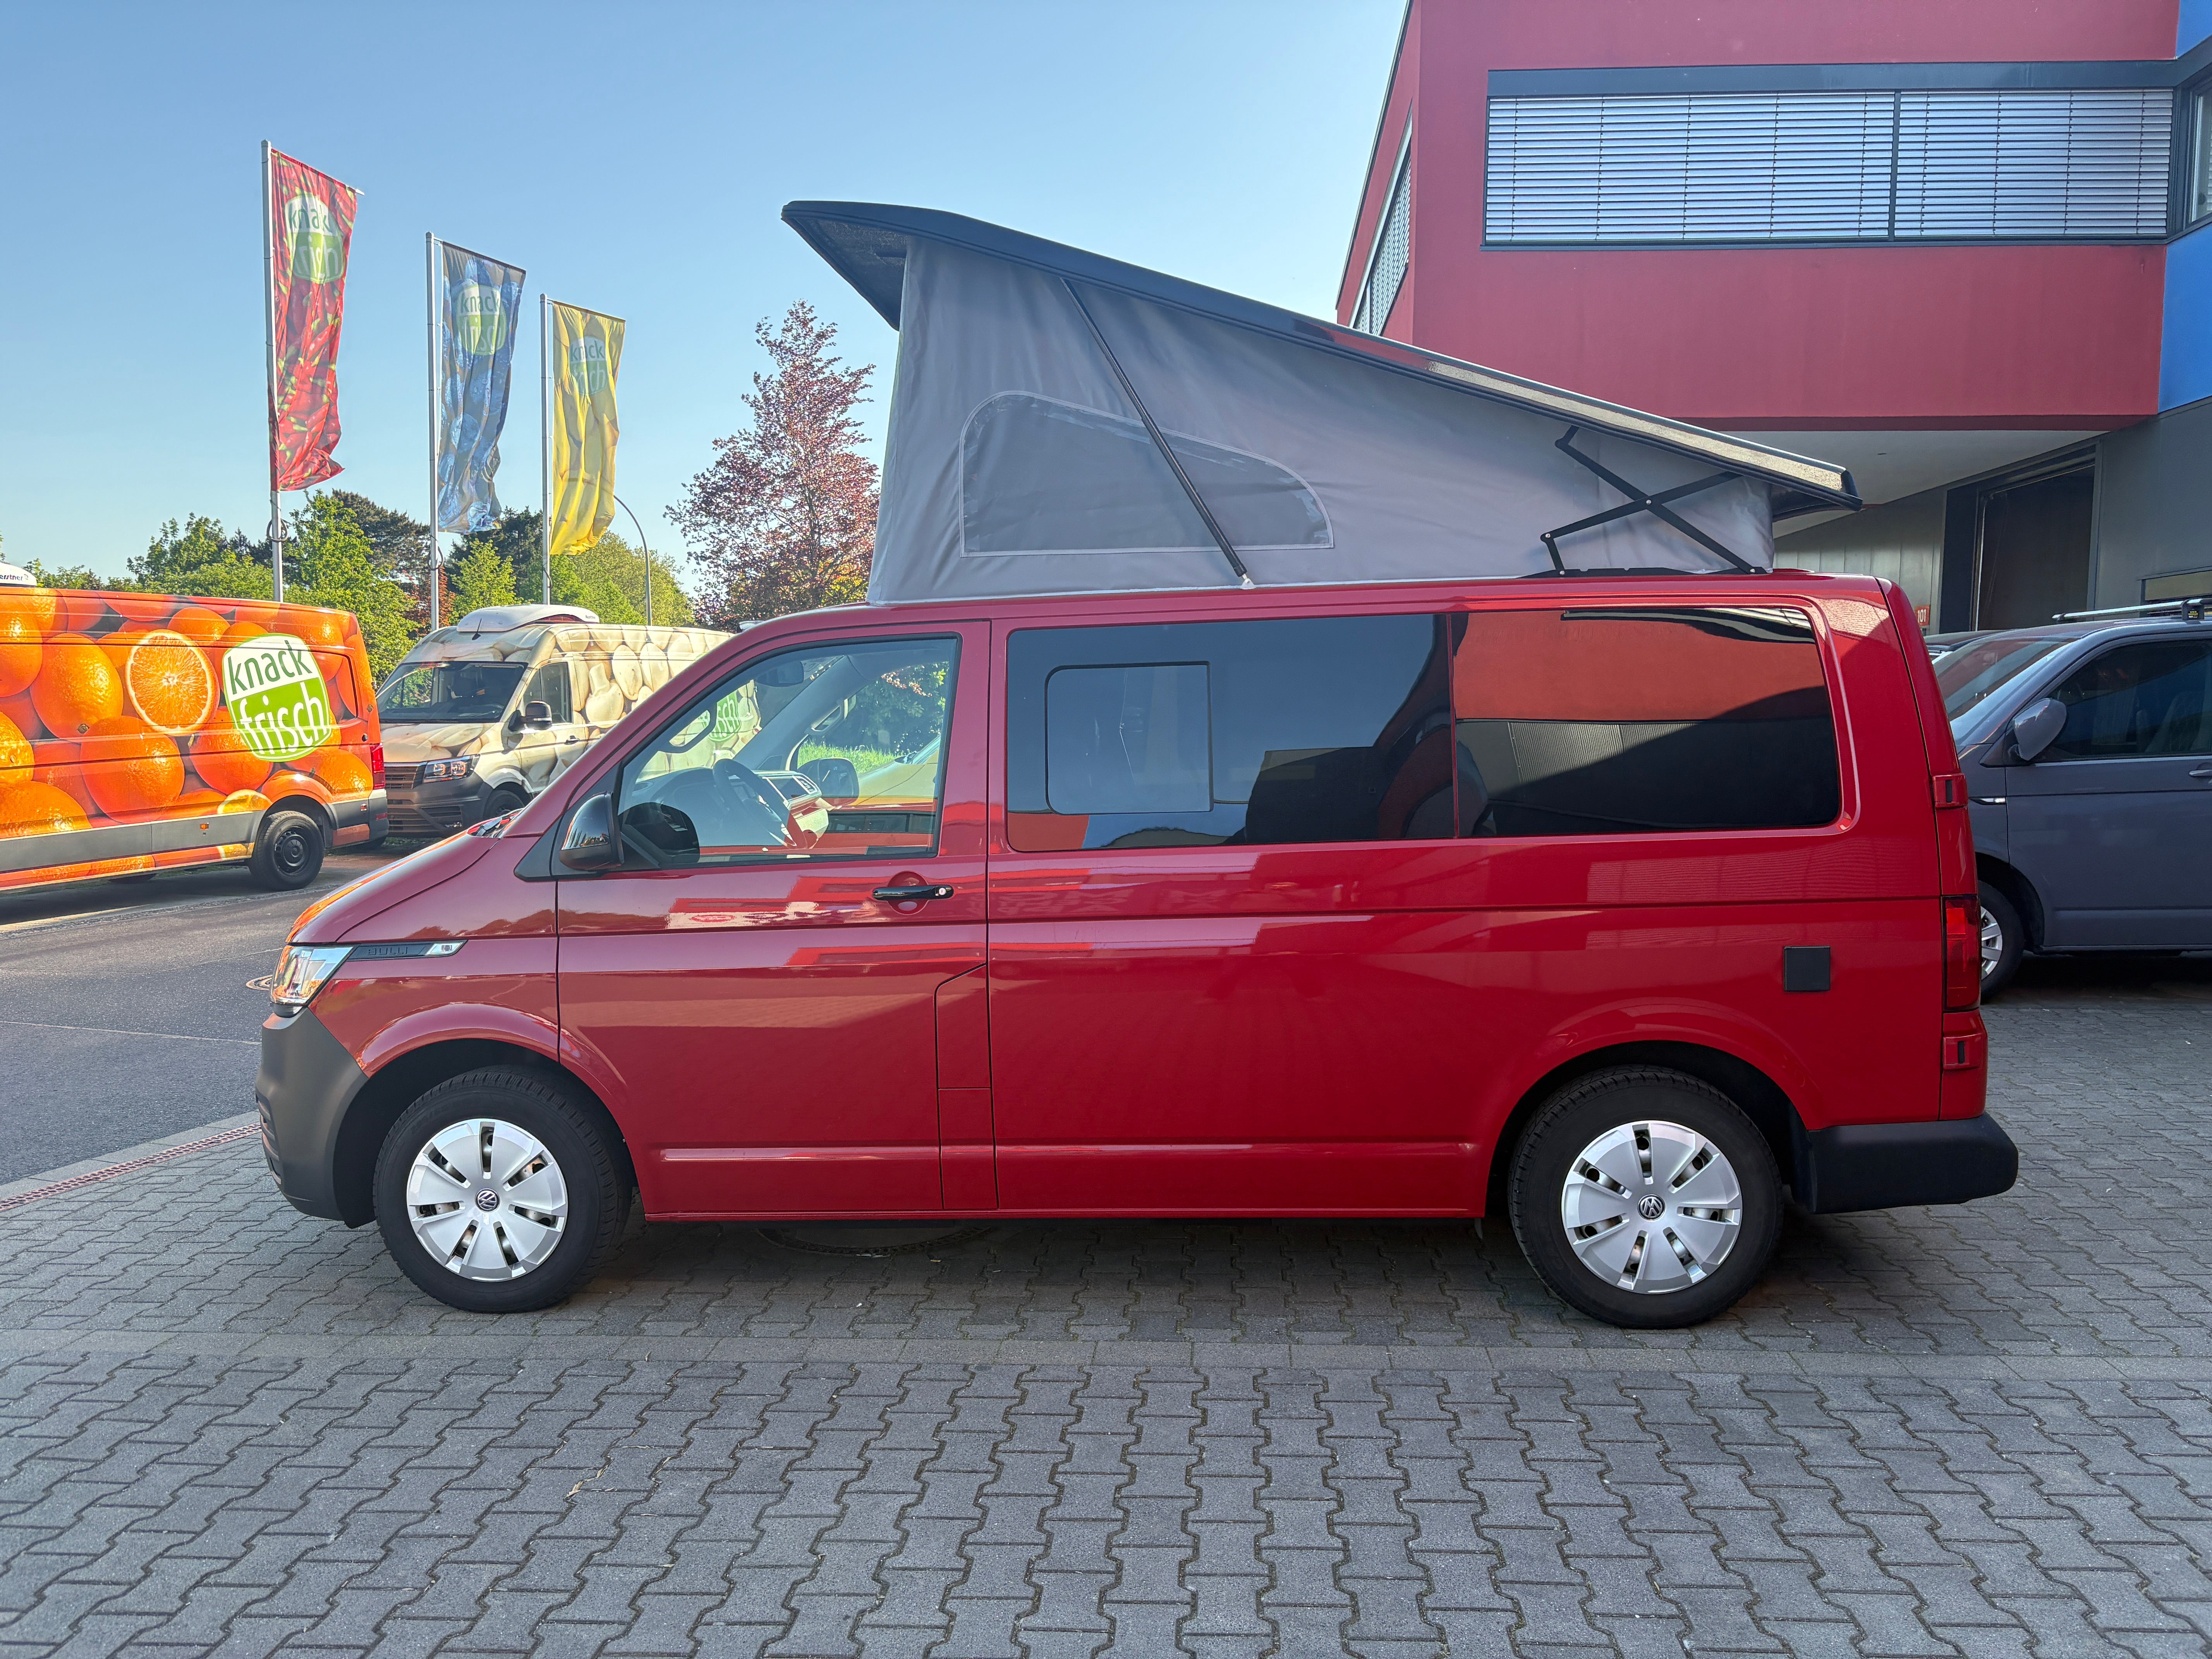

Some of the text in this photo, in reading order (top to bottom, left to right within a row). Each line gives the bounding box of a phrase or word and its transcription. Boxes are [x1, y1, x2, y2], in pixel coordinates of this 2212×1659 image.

[288, 203, 332, 232] knak
[571, 340, 605, 361] knck
[1918, 609, 1926, 623] 101
[228, 640, 313, 695] knack
[240, 682, 327, 754] frisch
